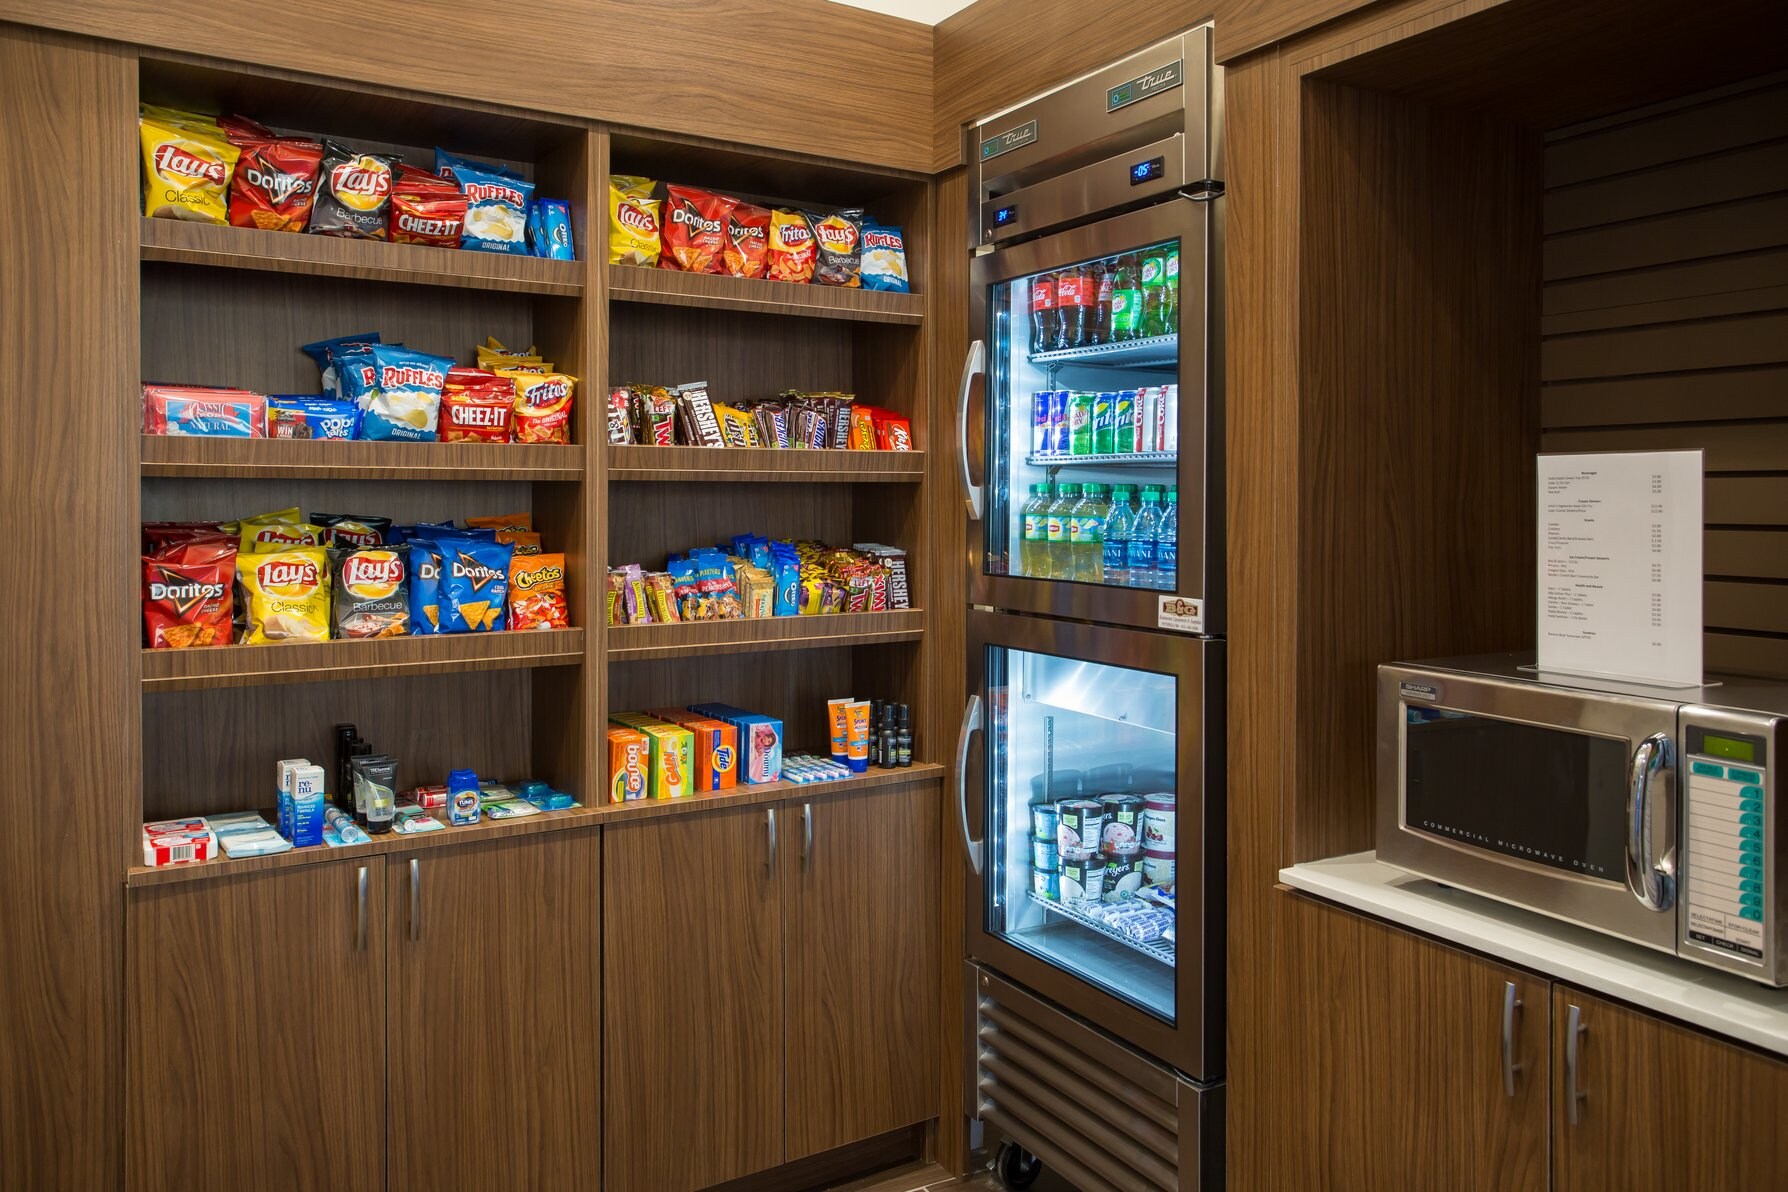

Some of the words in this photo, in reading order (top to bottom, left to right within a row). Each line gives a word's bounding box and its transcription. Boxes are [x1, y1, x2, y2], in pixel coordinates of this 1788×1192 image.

[158, 146, 224, 180] Lay's
[247, 169, 313, 193] Doritos
[335, 165, 390, 196] Lay's
[466, 183, 524, 208] RUFFLES
[673, 209, 721, 232] Doritos
[864, 232, 903, 249] RUFFLES
[829, 256, 859, 265] Barbecue
[381, 366, 444, 390] RUFFLES
[525, 382, 568, 407] Fritos
[391, 428, 421, 440] ORIGINAL
[653, 414, 673, 446] TW
[836, 407, 850, 449] HERSHEY
[263, 562, 318, 587] Lay's
[349, 558, 400, 585] Lay's
[453, 562, 505, 580] Doritos
[515, 567, 562, 590] Cheetos
[150, 583, 224, 600] Doritos
[891, 561, 910, 609] HERSHEY
[353, 601, 402, 612] Barbecue
[850, 589, 868, 612] TW
[626, 743, 642, 792] bounce
[717, 747, 730, 770] Tide
[1423, 820, 1489, 842] COMMERCIAL
[1498, 840, 1563, 862] MICROWAVE
[1573, 859, 1604, 873] OVEN
